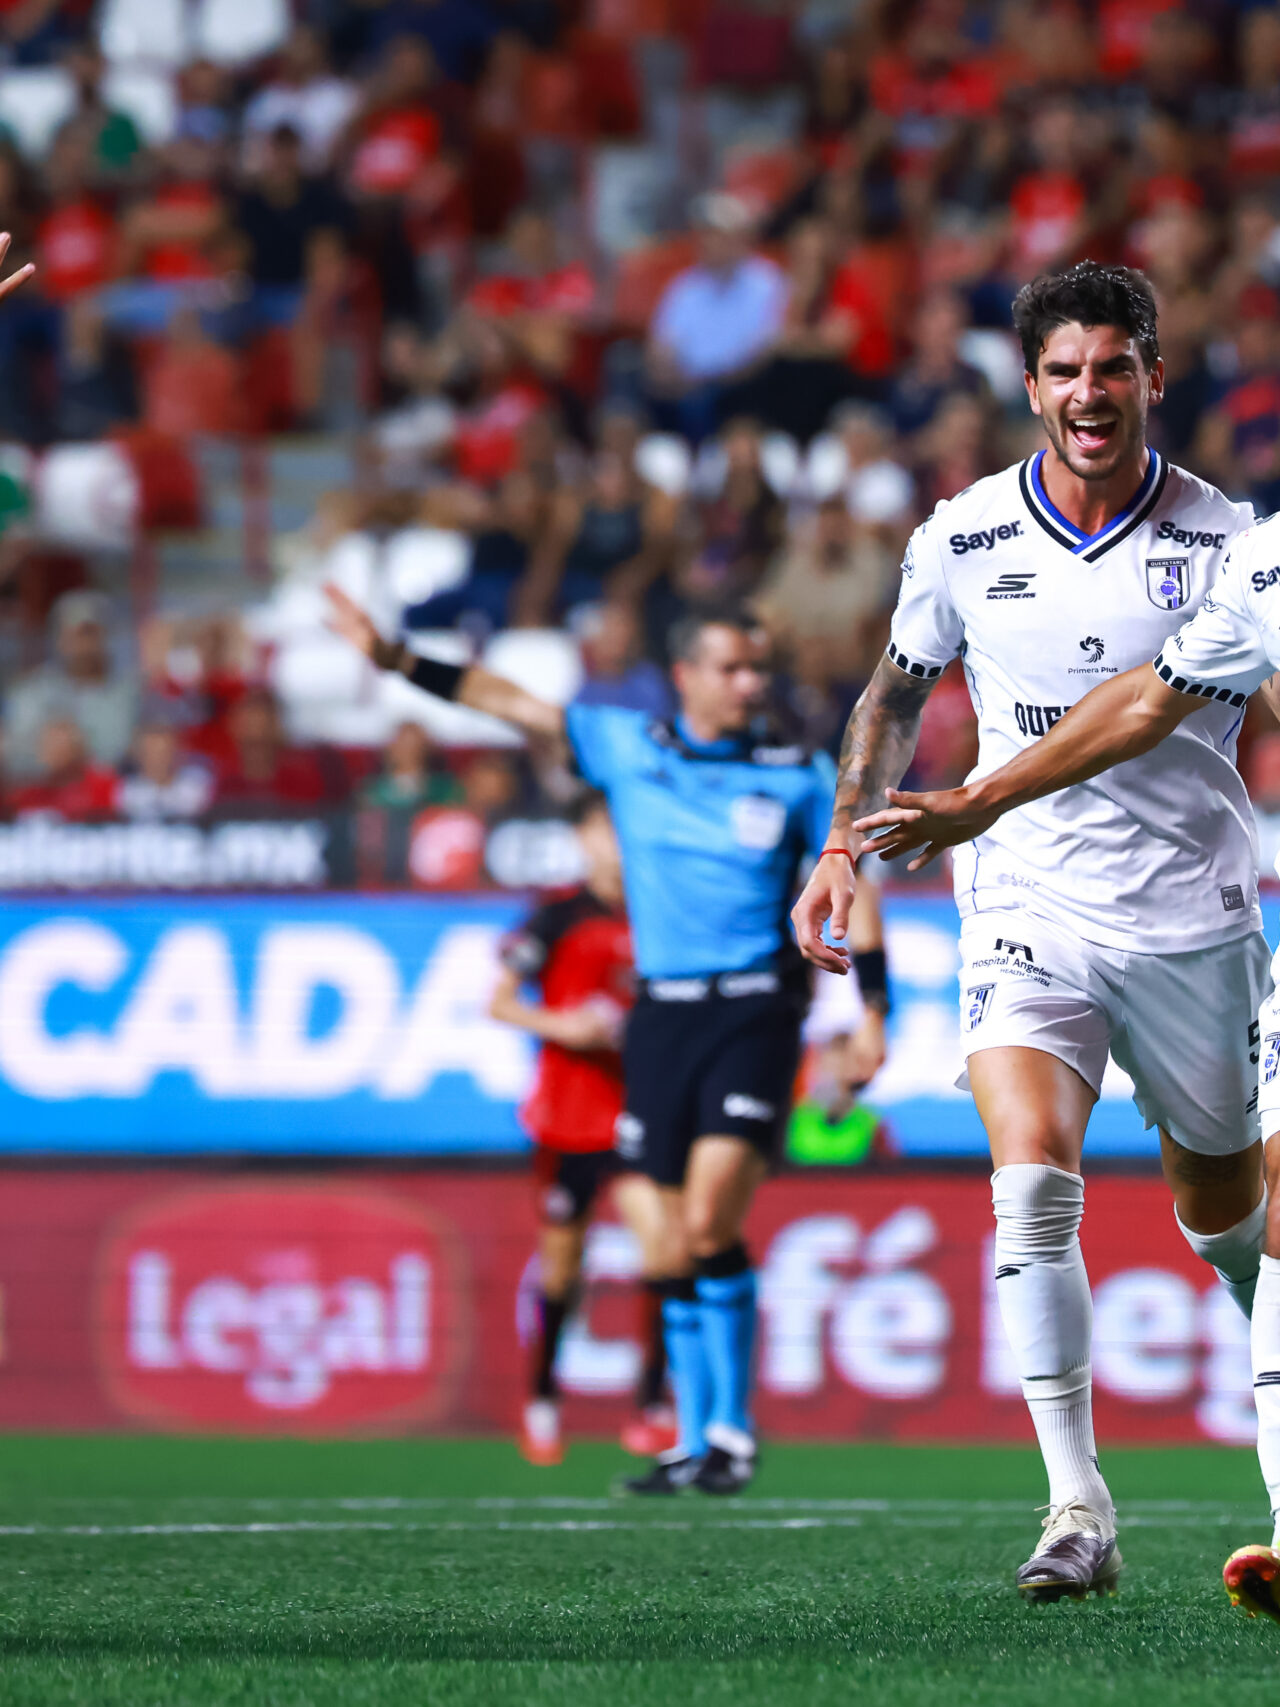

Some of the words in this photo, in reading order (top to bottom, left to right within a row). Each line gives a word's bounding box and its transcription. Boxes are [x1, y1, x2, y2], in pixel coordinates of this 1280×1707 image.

[986, 592, 1036, 600] SKECHERS
[1067, 667, 1100, 675] Primera
[972, 956, 1008, 969] Hospital
[553, 1206, 952, 1399] Cfé
[128, 1248, 432, 1411] Legal
